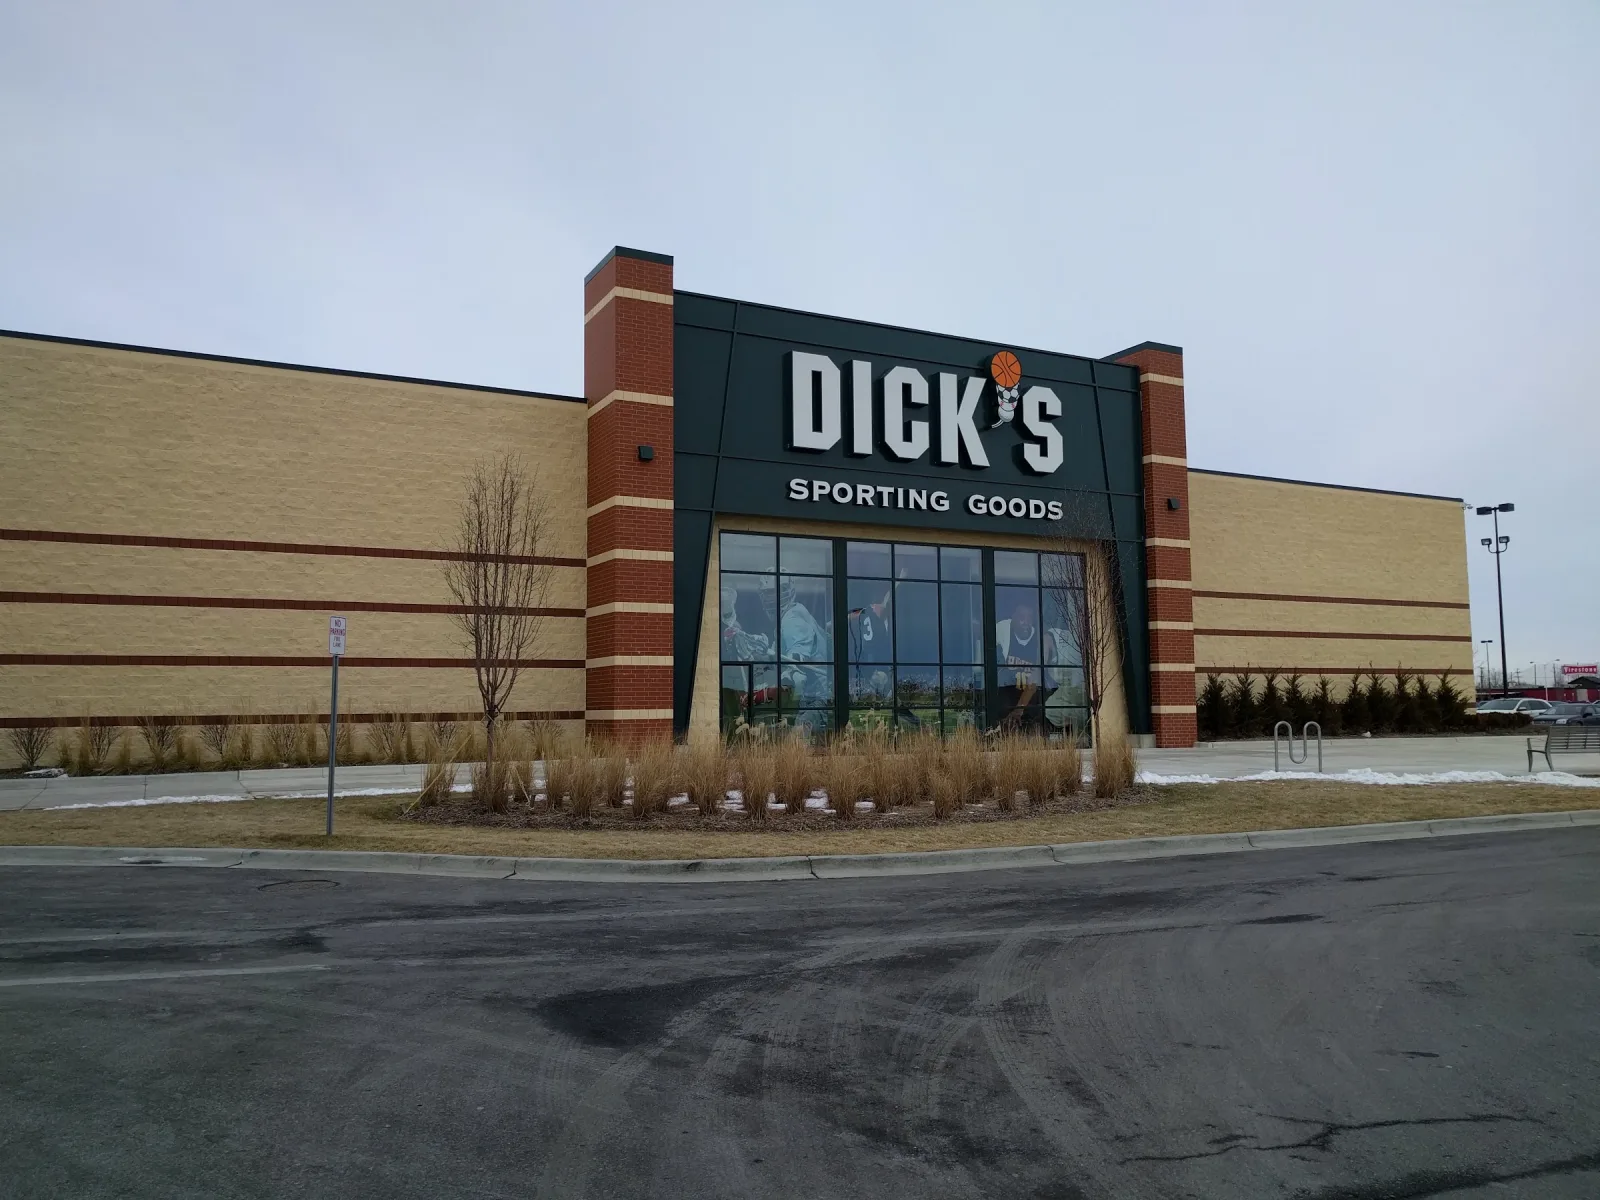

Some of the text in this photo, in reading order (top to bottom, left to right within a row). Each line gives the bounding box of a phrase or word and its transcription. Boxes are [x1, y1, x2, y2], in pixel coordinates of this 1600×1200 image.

[791, 350, 1064, 474] DICK'S
[789, 478, 1064, 521] SPORTING GOODS
[334, 619, 342, 627] NO
